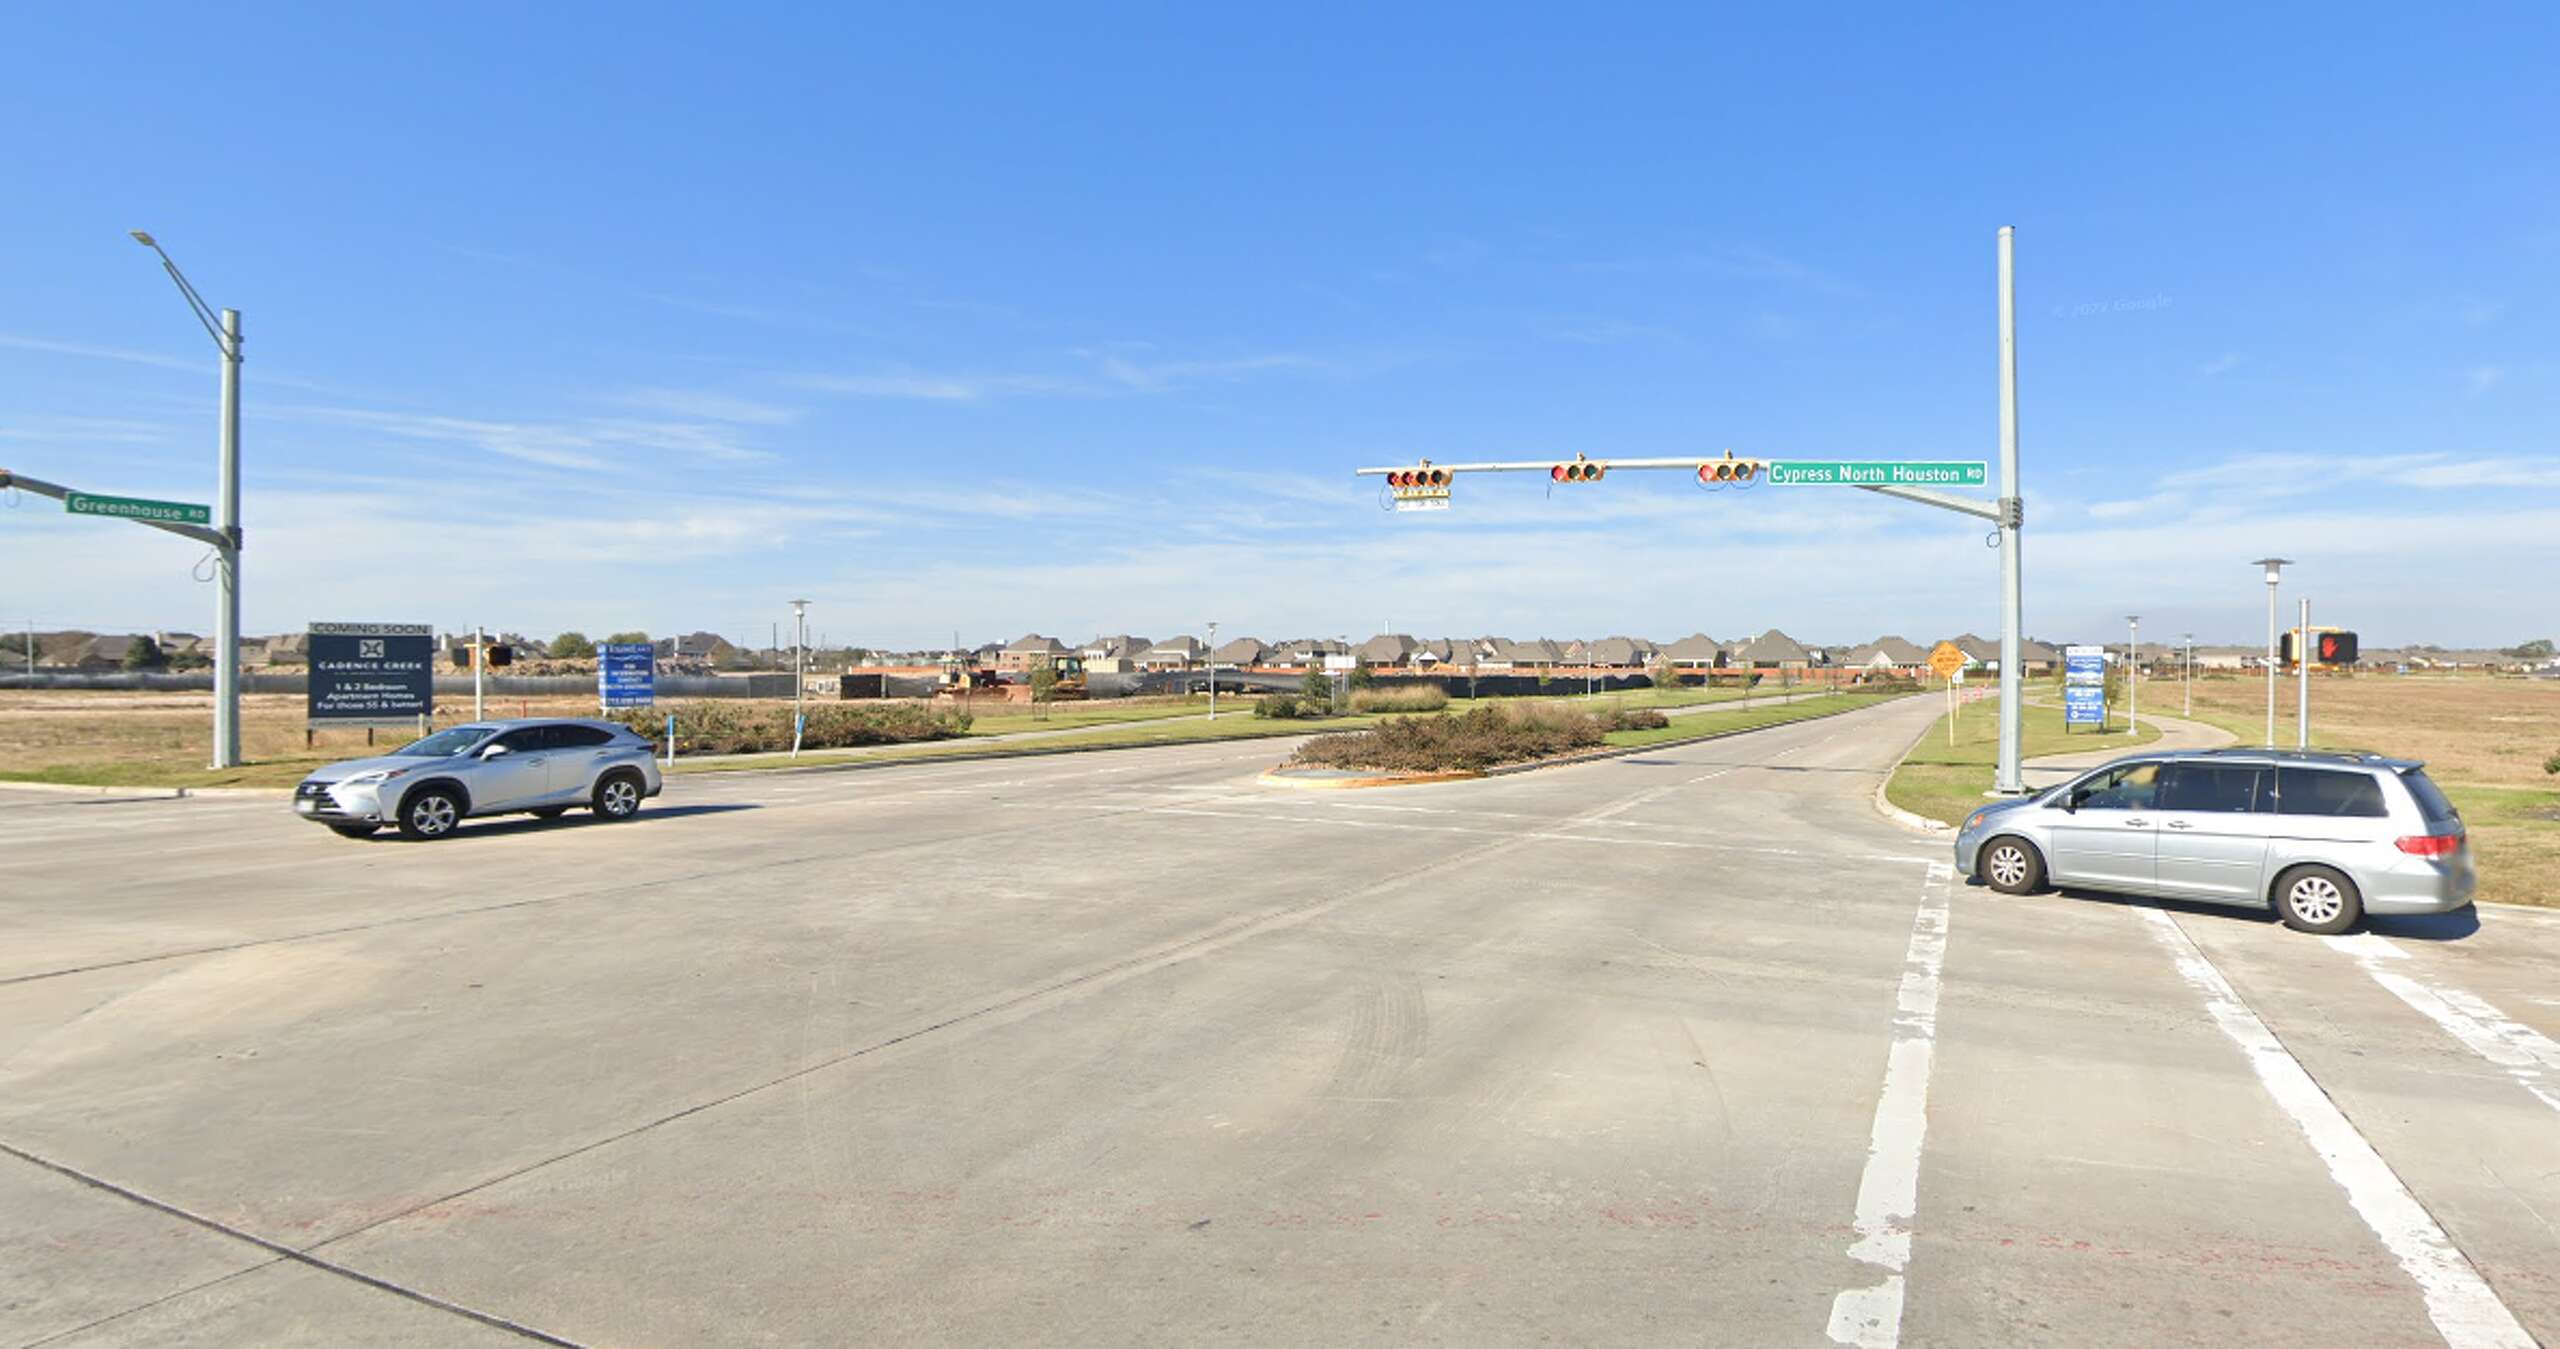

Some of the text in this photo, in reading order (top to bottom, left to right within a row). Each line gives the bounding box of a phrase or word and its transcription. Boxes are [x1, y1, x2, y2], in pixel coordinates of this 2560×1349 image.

[1772, 465, 1984, 483] Cypress North Houston RD
[73, 497, 206, 520] Greenhouse RD
[314, 623, 428, 635] COMING SOON
[318, 661, 422, 670] CADENCE CREEK
[343, 683, 352, 691] &
[354, 683, 361, 691] 2
[363, 682, 408, 691] Bedroom
[326, 692, 415, 702] Apartment Homes
[316, 702, 334, 710] For
[335, 702, 364, 710] those
[380, 702, 389, 710] &
